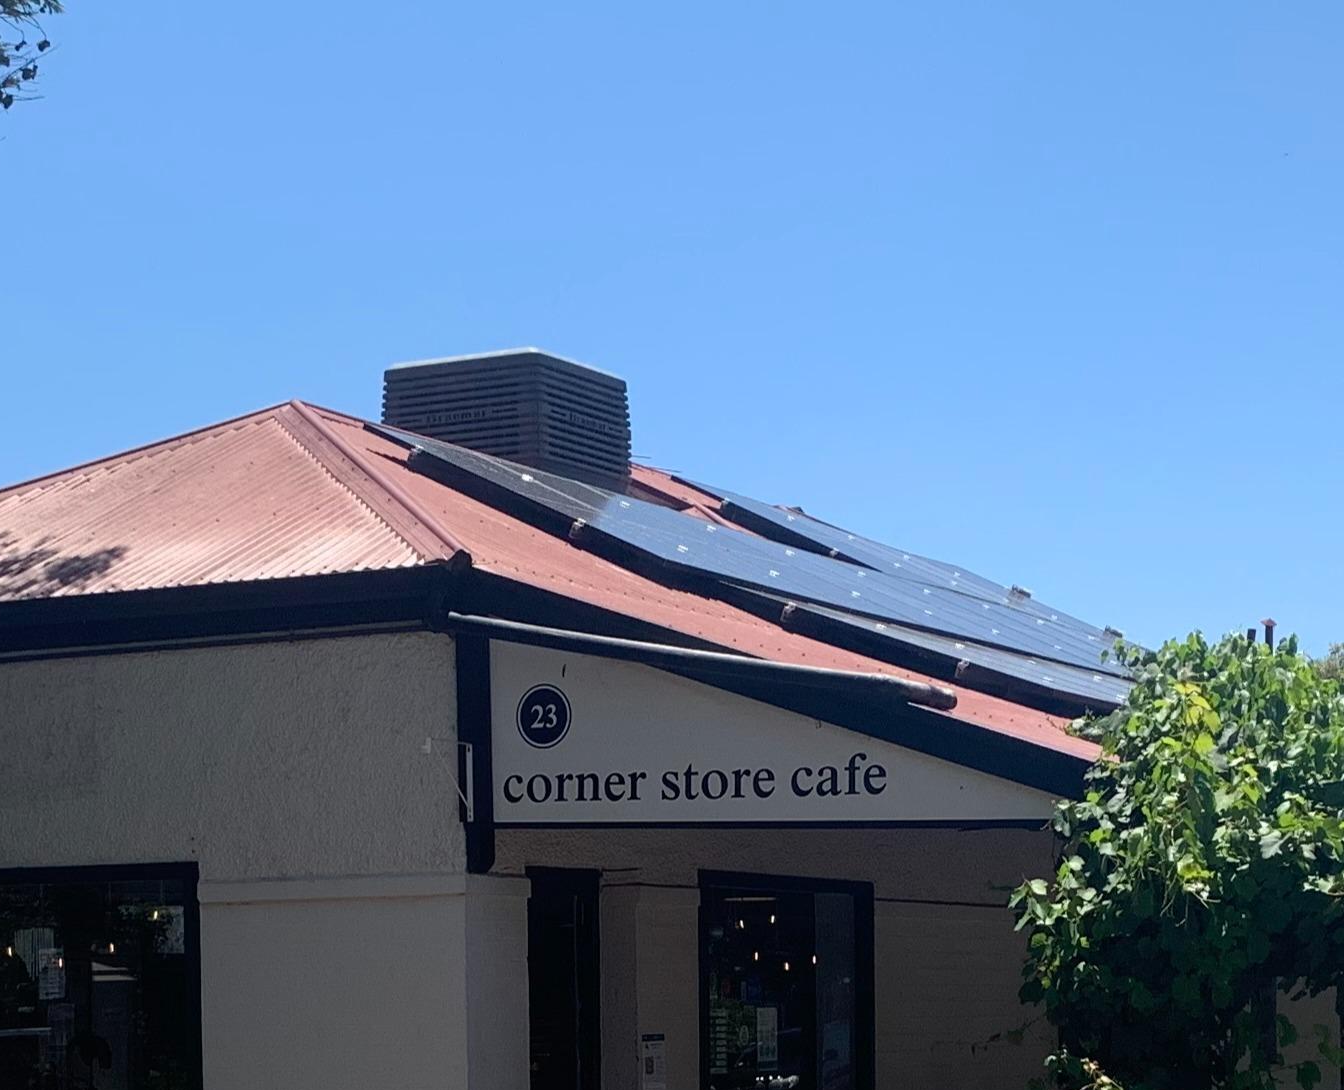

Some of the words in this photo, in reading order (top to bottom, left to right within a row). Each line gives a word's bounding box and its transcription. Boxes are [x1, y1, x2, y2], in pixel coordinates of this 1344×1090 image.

[529, 704, 558, 729] 23
[502, 769, 646, 803] corner
[660, 763, 775, 801] store
[790, 752, 887, 796] cafe
